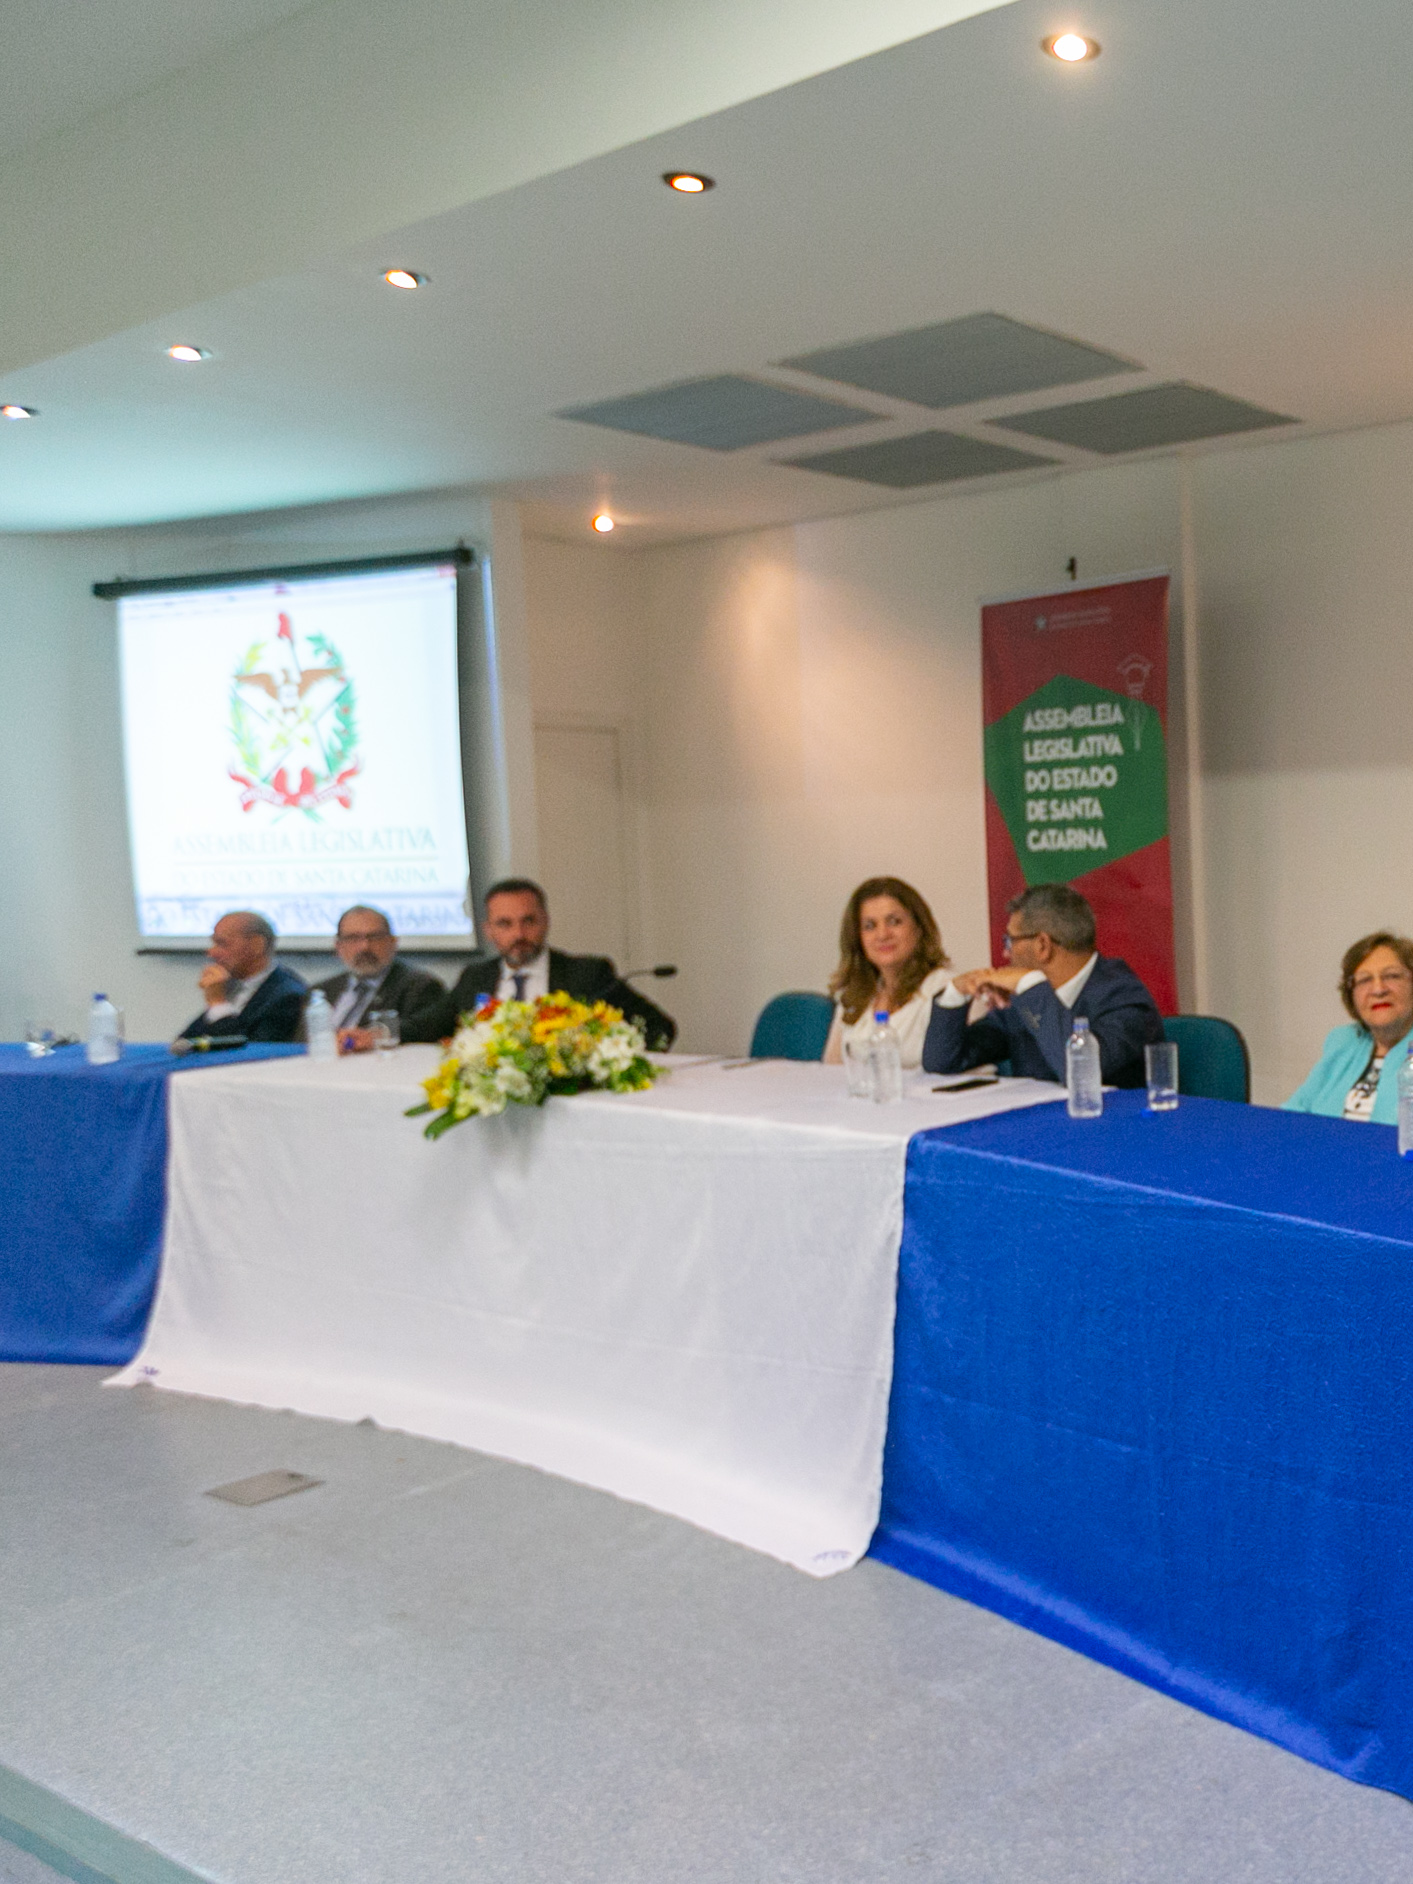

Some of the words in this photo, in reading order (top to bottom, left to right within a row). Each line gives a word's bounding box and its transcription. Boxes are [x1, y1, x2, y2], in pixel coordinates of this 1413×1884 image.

[1023, 703, 1125, 733] ASSEMBLEIA
[1023, 733, 1124, 763] LEGISLATIVA
[1024, 768, 1050, 792] DO
[1051, 764, 1118, 791] ESTADO
[1025, 799, 1048, 822] DE
[1049, 796, 1104, 821] SANTA
[1026, 827, 1108, 851] CATARINA
